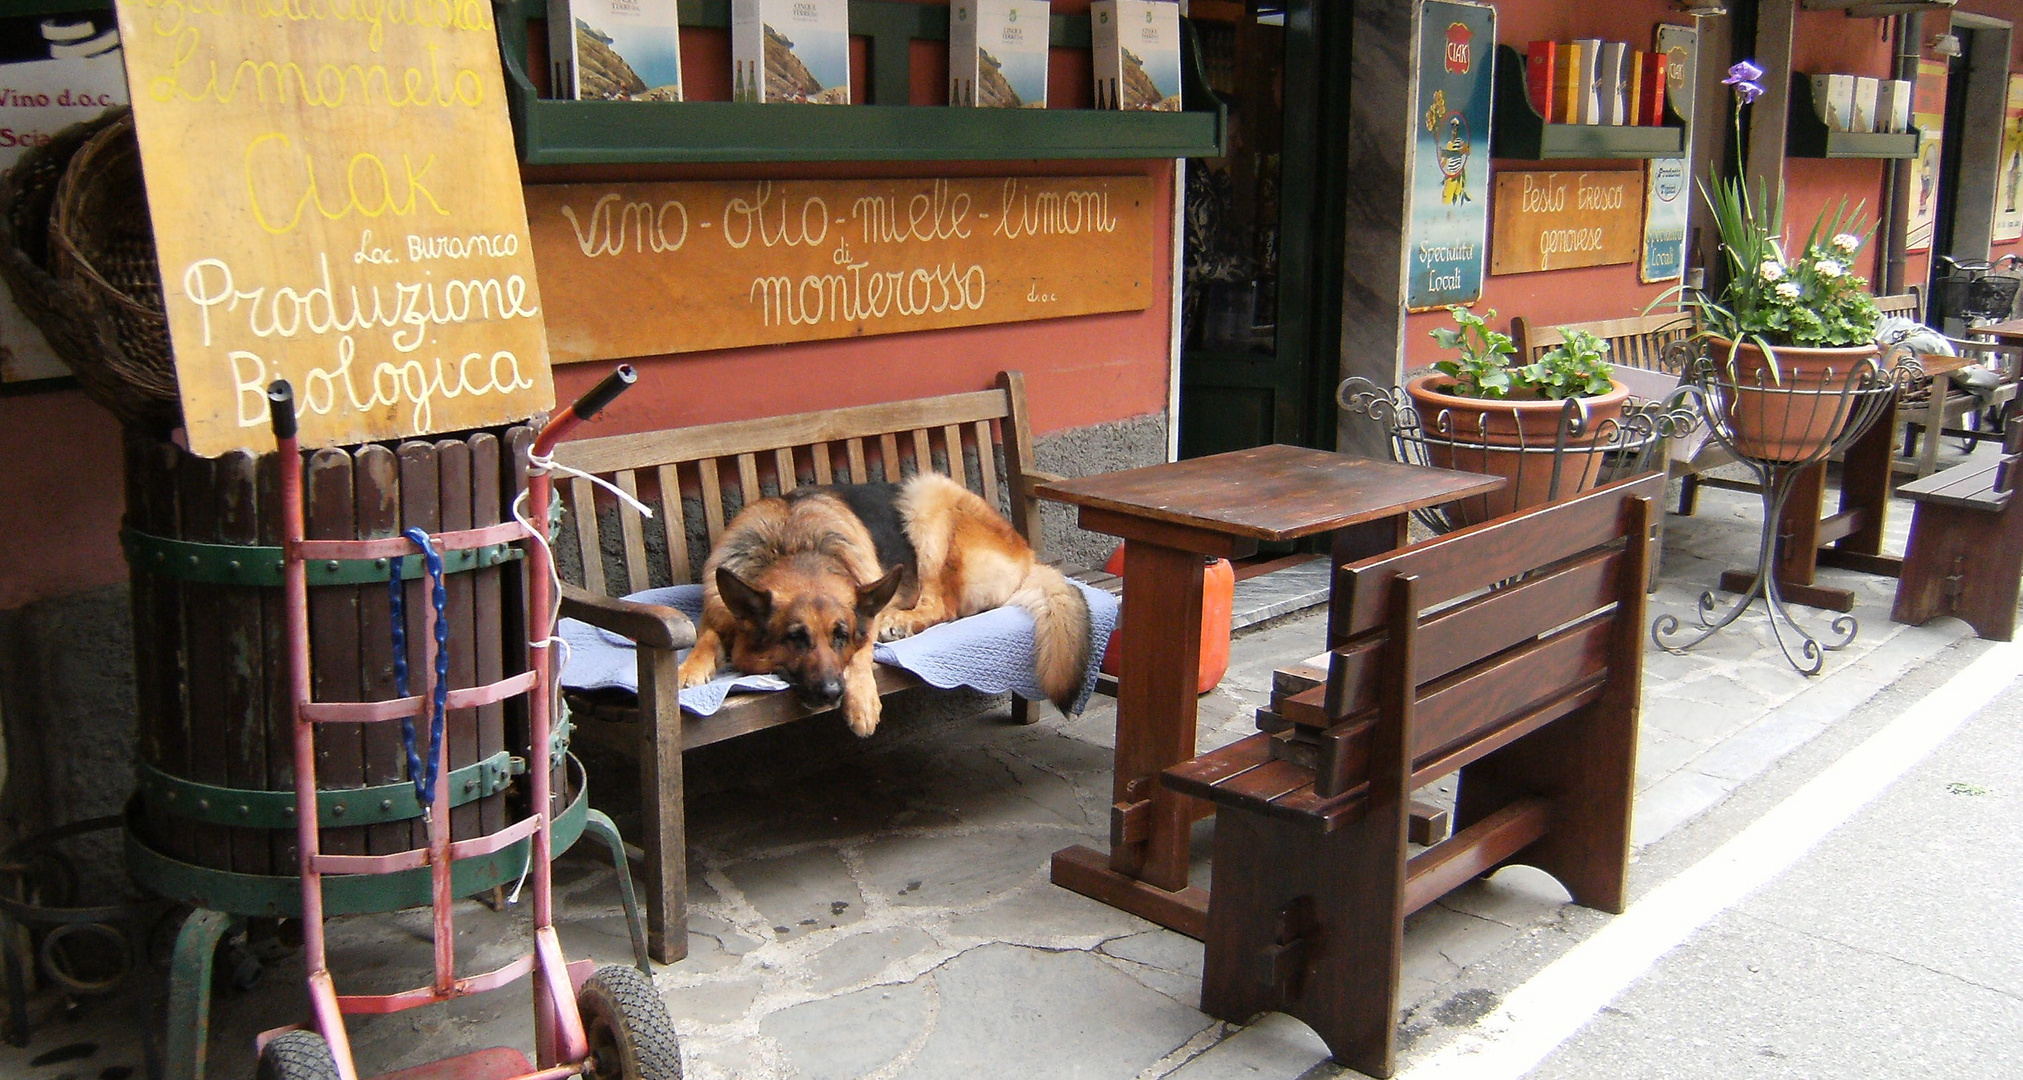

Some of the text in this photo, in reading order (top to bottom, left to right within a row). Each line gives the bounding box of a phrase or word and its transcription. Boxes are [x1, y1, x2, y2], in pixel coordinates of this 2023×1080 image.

[148, 27, 484, 107] Limoneto
[1448, 43, 1468, 63] CIAK
[1522, 173, 1567, 213] Pesto
[723, 180, 828, 249] olio
[852, 178, 971, 242] miele
[993, 178, 1116, 239] limoni
[354, 229, 399, 264] Loc.
[833, 236, 853, 265] di
[1540, 227, 1603, 271] genovese
[1428, 267, 1461, 292] Locali
[184, 252, 537, 352] Produzione
